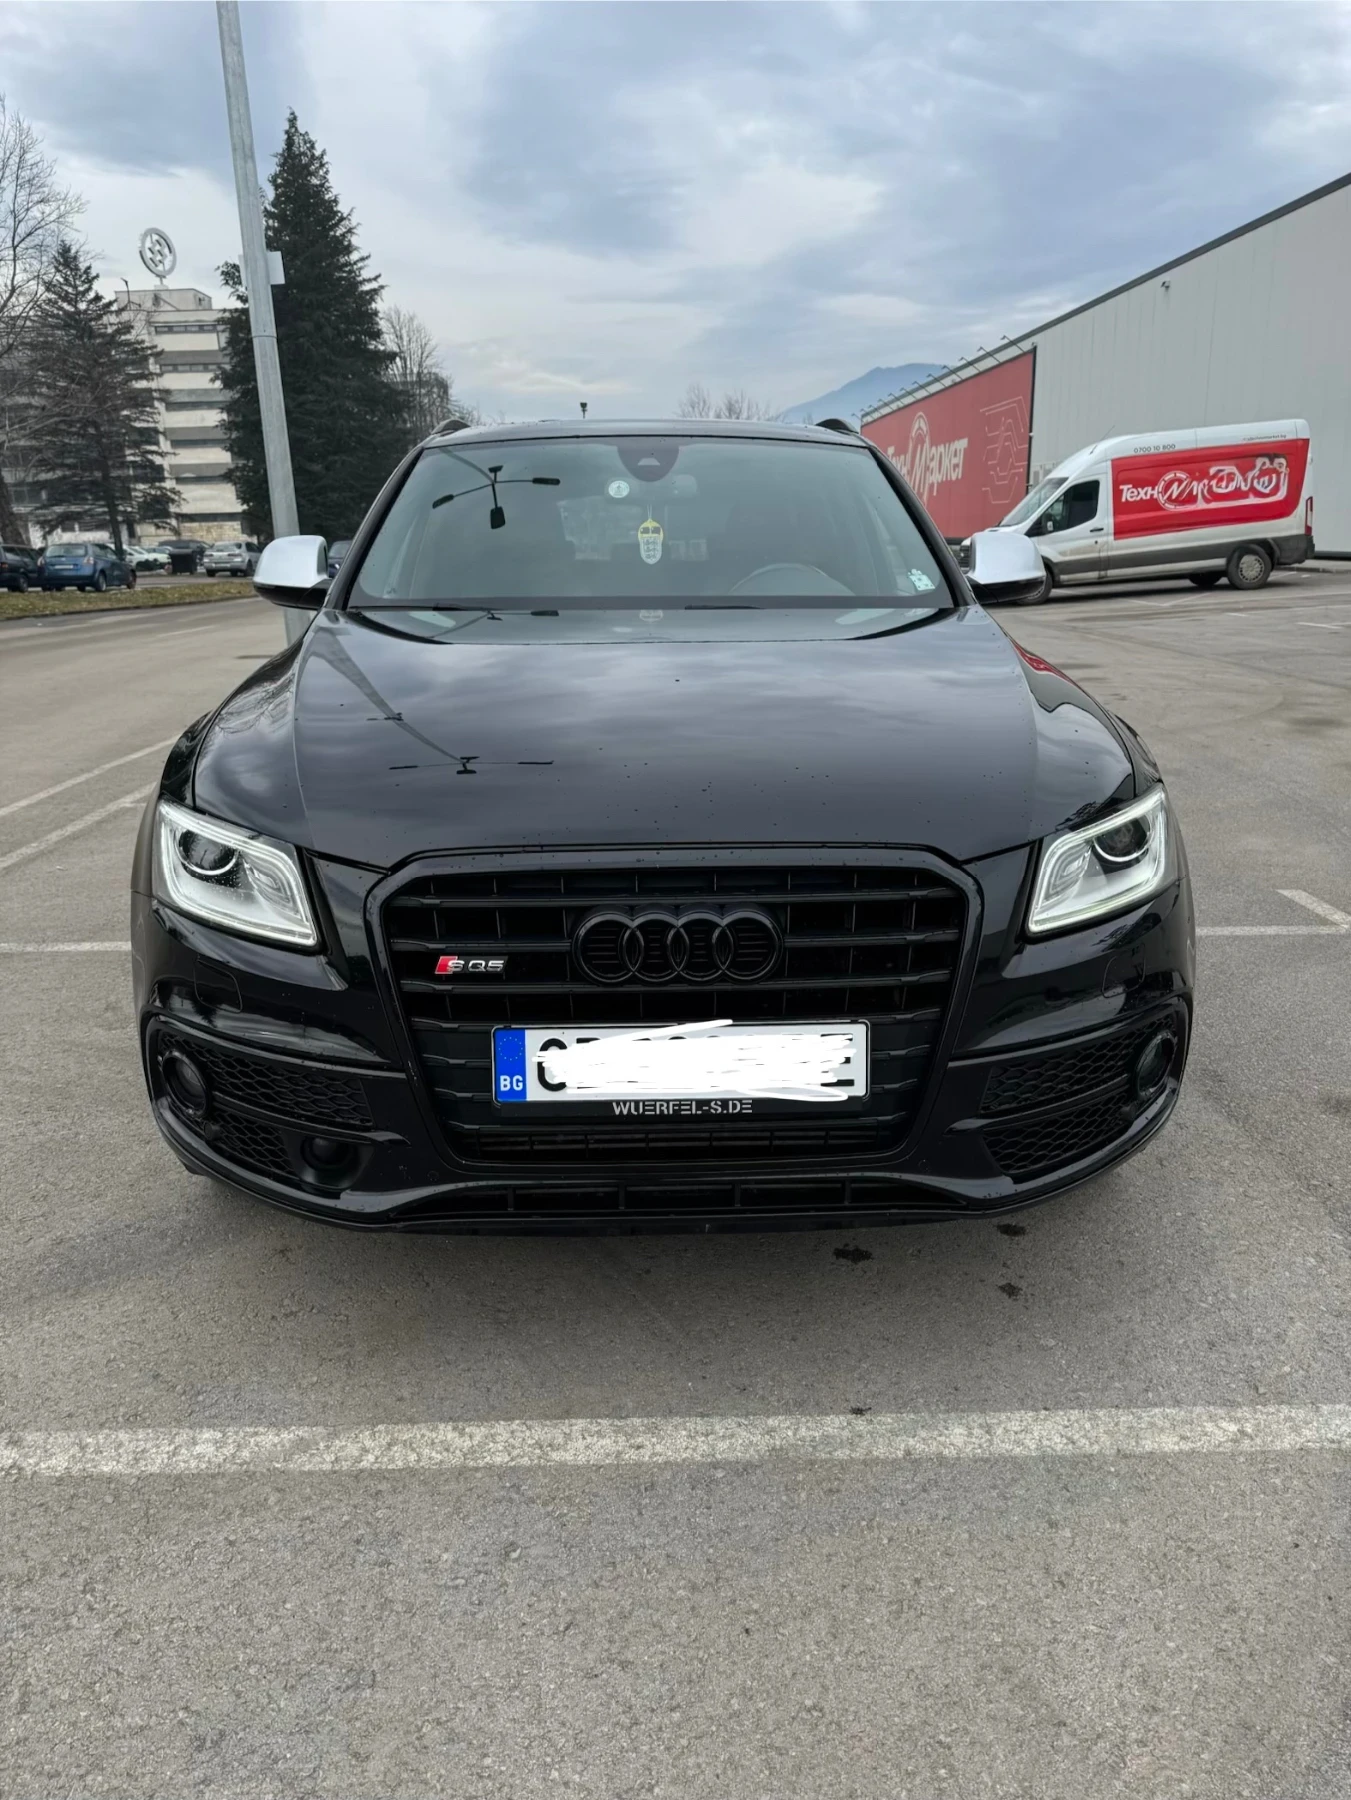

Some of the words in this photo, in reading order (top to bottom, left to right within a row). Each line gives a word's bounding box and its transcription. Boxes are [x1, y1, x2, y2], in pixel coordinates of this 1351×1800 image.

[1133, 445, 1152, 454] 0700
[1162, 443, 1176, 451] 800
[447, 960, 504, 972] SQ5
[500, 1074, 523, 1092] BG
[612, 1099, 753, 1116] WUERFEL-S.DE
